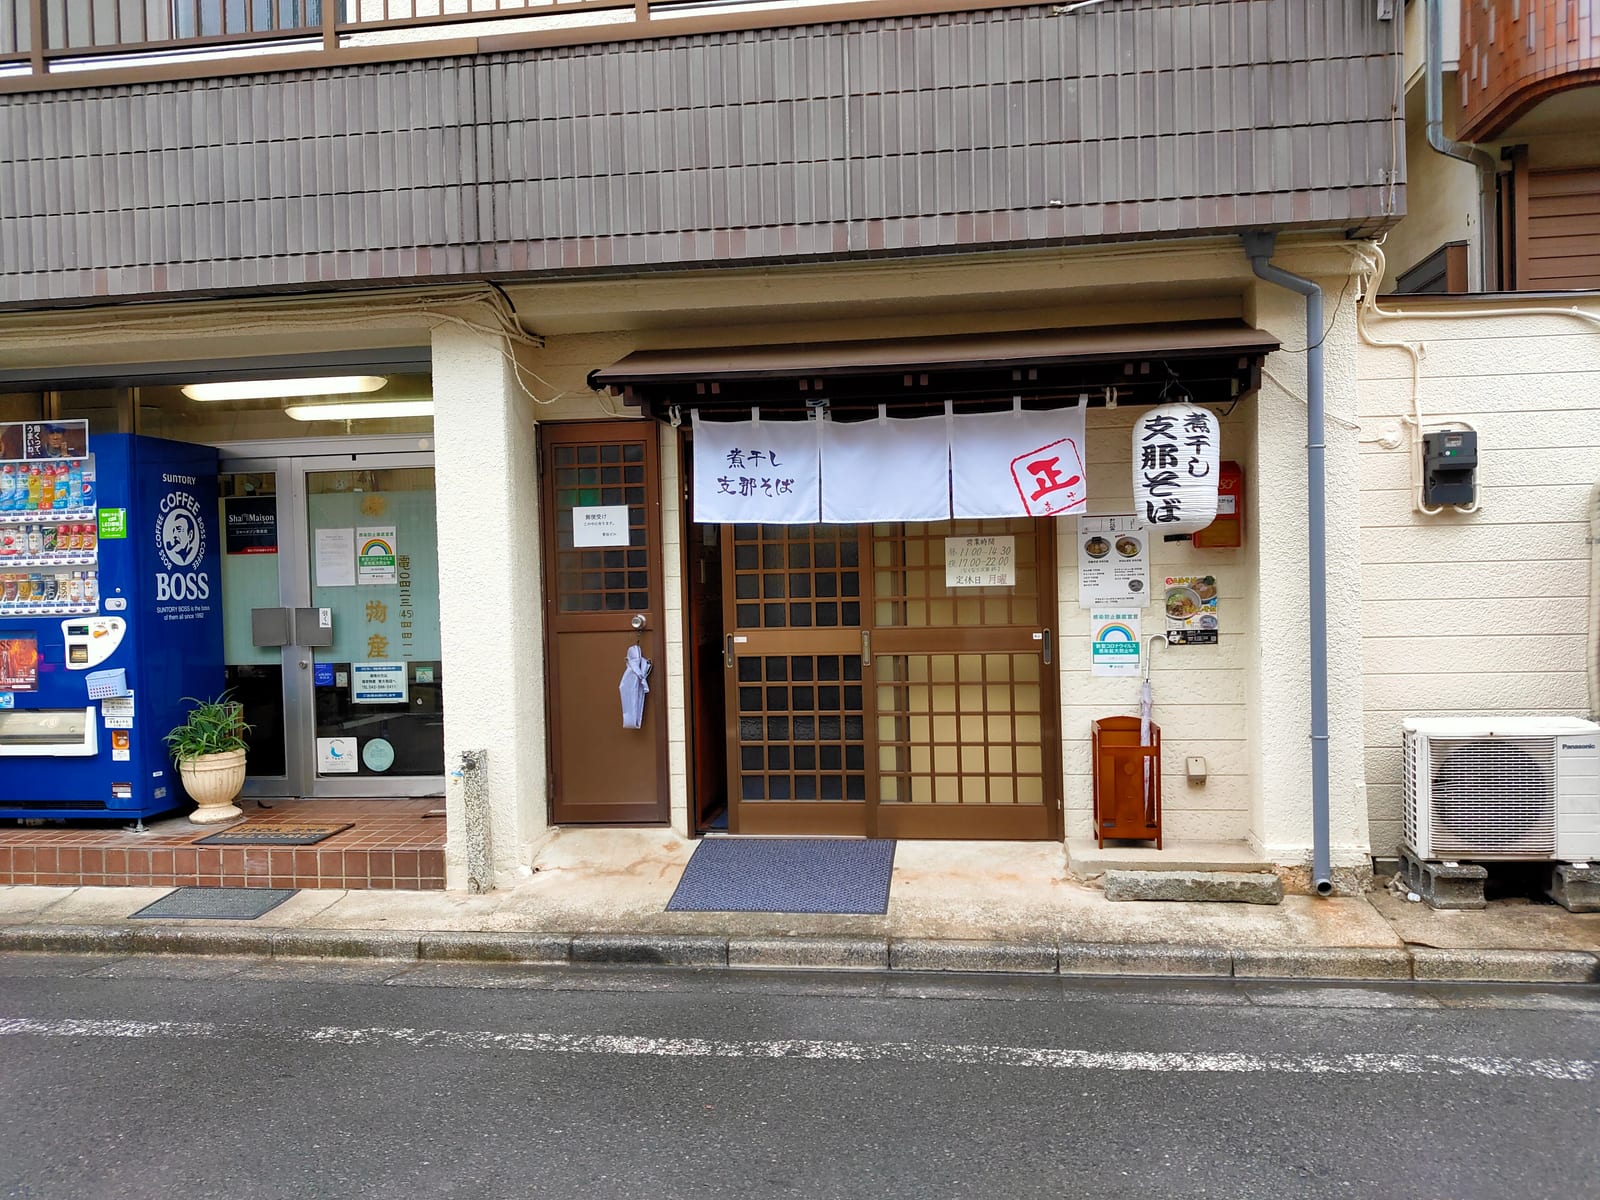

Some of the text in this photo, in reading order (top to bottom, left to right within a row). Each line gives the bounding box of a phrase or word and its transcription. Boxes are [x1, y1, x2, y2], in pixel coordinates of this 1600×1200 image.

[727, 448, 783, 469] 煮干し
[1183, 412, 1211, 478] 煮干し
[162, 473, 196, 485] SUNTORY
[1027, 456, 1080, 501] 正
[1141, 415, 1182, 524] 支那そば
[717, 475, 795, 497] 支那そば
[160, 491, 200, 516] COFFEE
[155, 513, 172, 571] BOSS COFFEE
[192, 516, 206, 570] BOSS COFFEE
[966, 538, 995, 546] 営業時間
[155, 572, 210, 601] BOSS
[955, 575, 981, 584] 定休日
